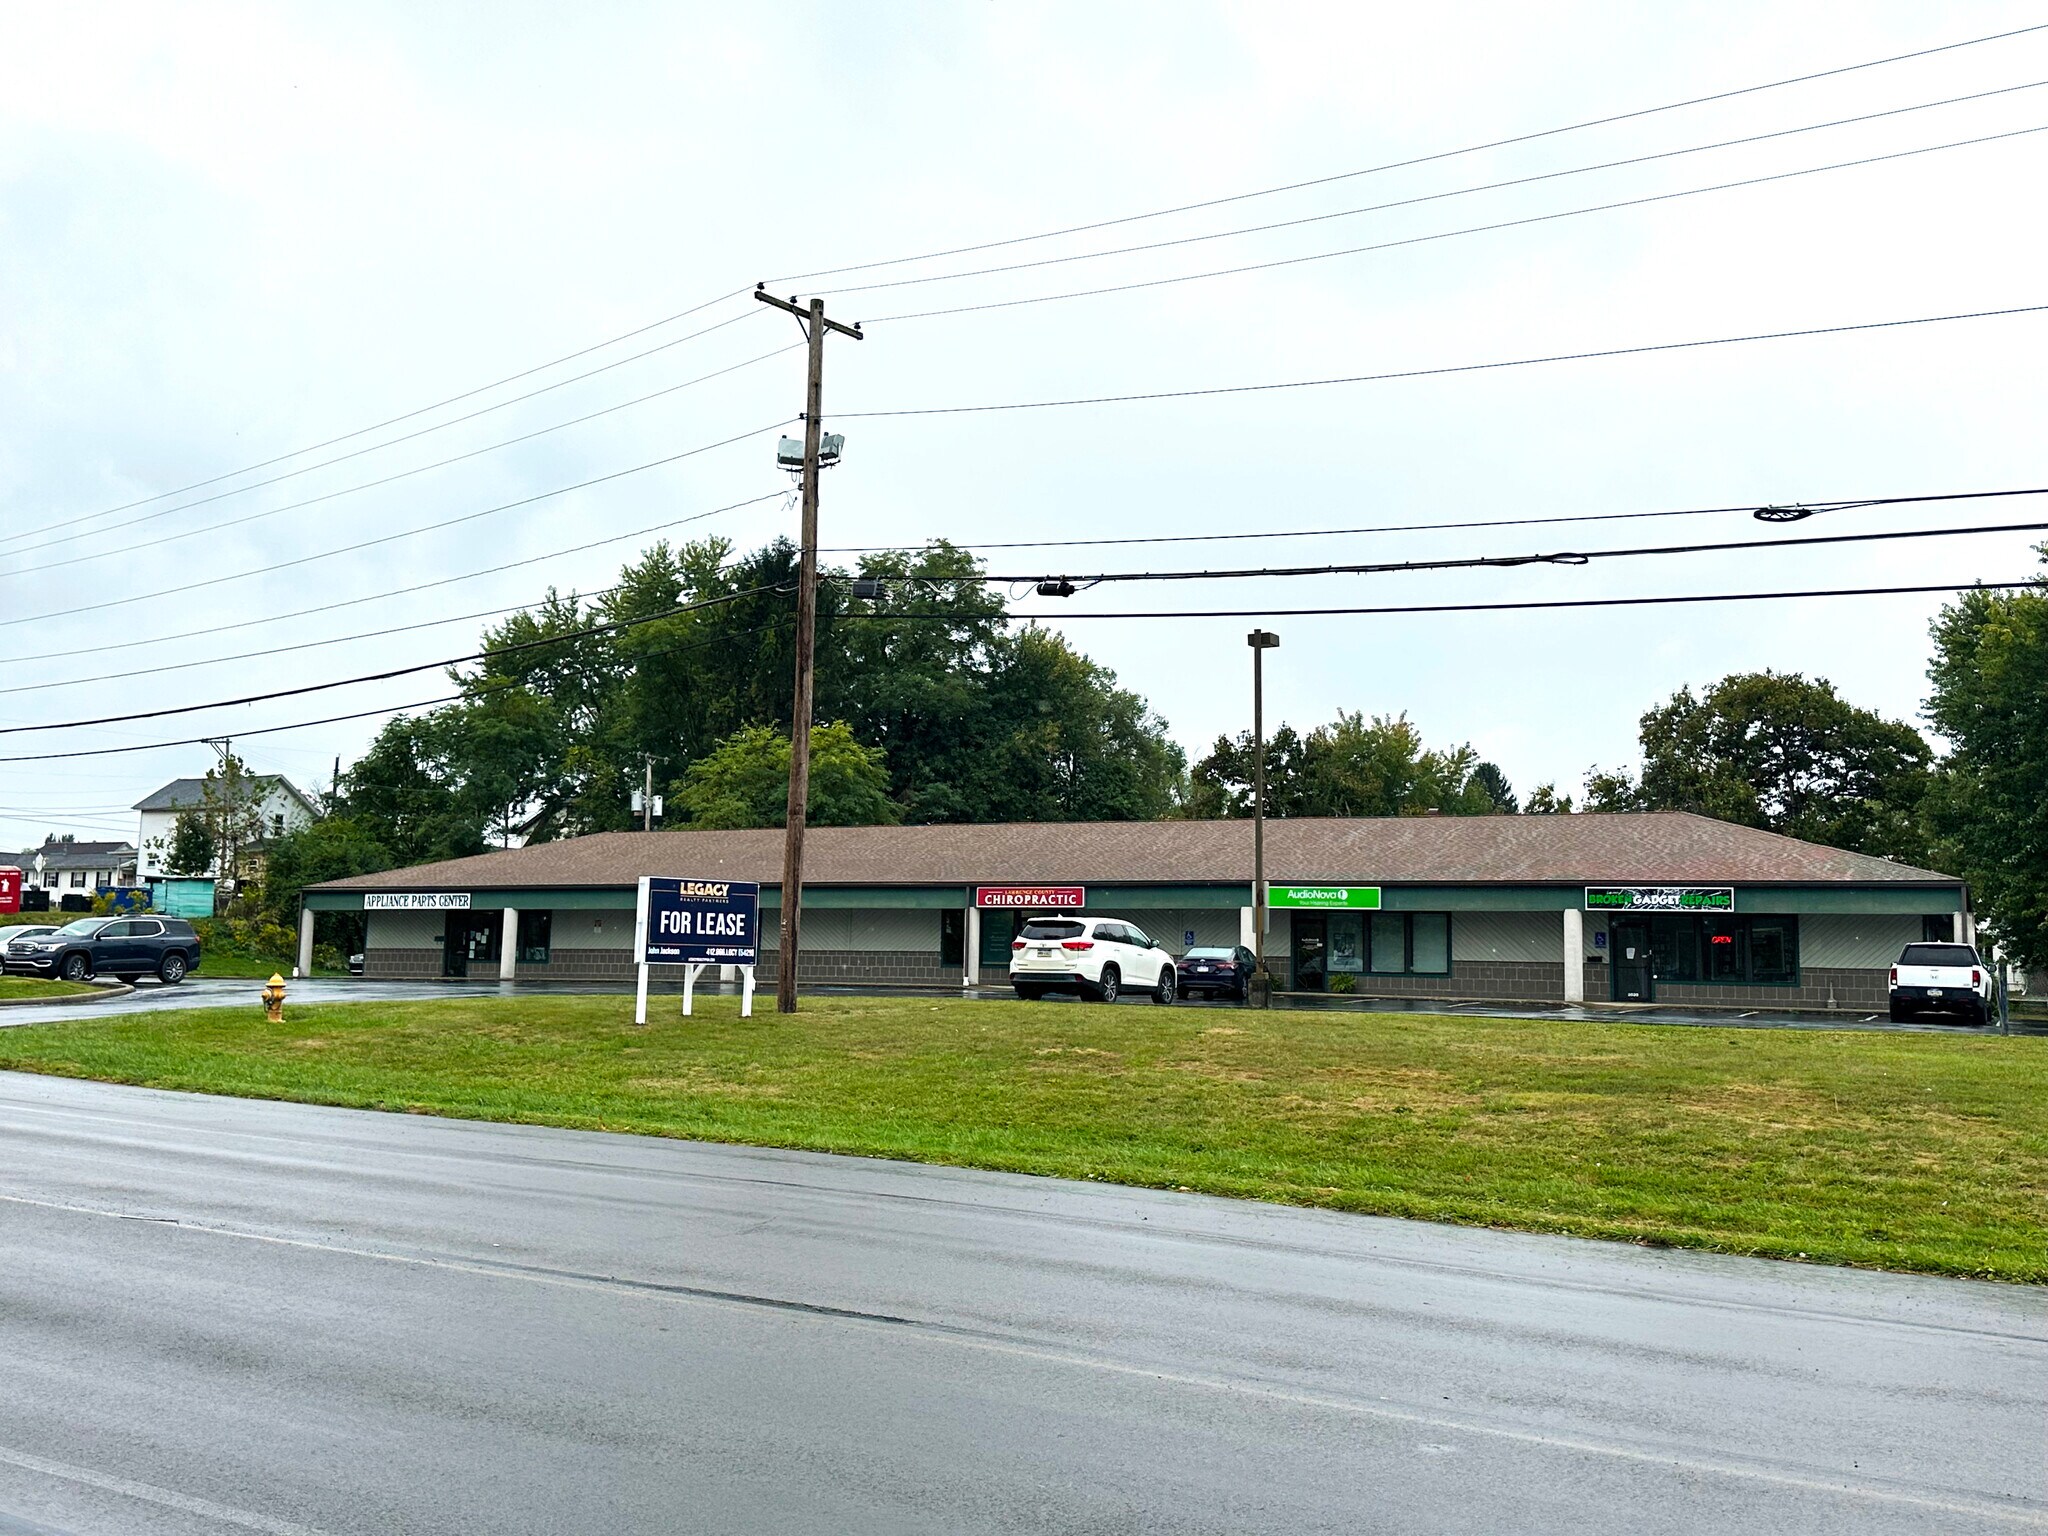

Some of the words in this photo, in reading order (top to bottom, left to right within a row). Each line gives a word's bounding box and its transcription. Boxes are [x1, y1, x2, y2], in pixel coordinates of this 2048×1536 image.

[680, 882, 730, 896] LEGACY
[1287, 889, 1337, 899] AudioNova
[366, 895, 410, 907] APPLIANCE
[411, 895, 437, 907] PARTS
[439, 895, 469, 907] CENTER
[984, 894, 1077, 905] CHIROPRACTIC
[1632, 894, 1681, 905] GADGET
[660, 911, 692, 934] FOR
[696, 912, 746, 936] LEASE
[1711, 936, 1732, 944] OPEN
[648, 946, 659, 954] John
